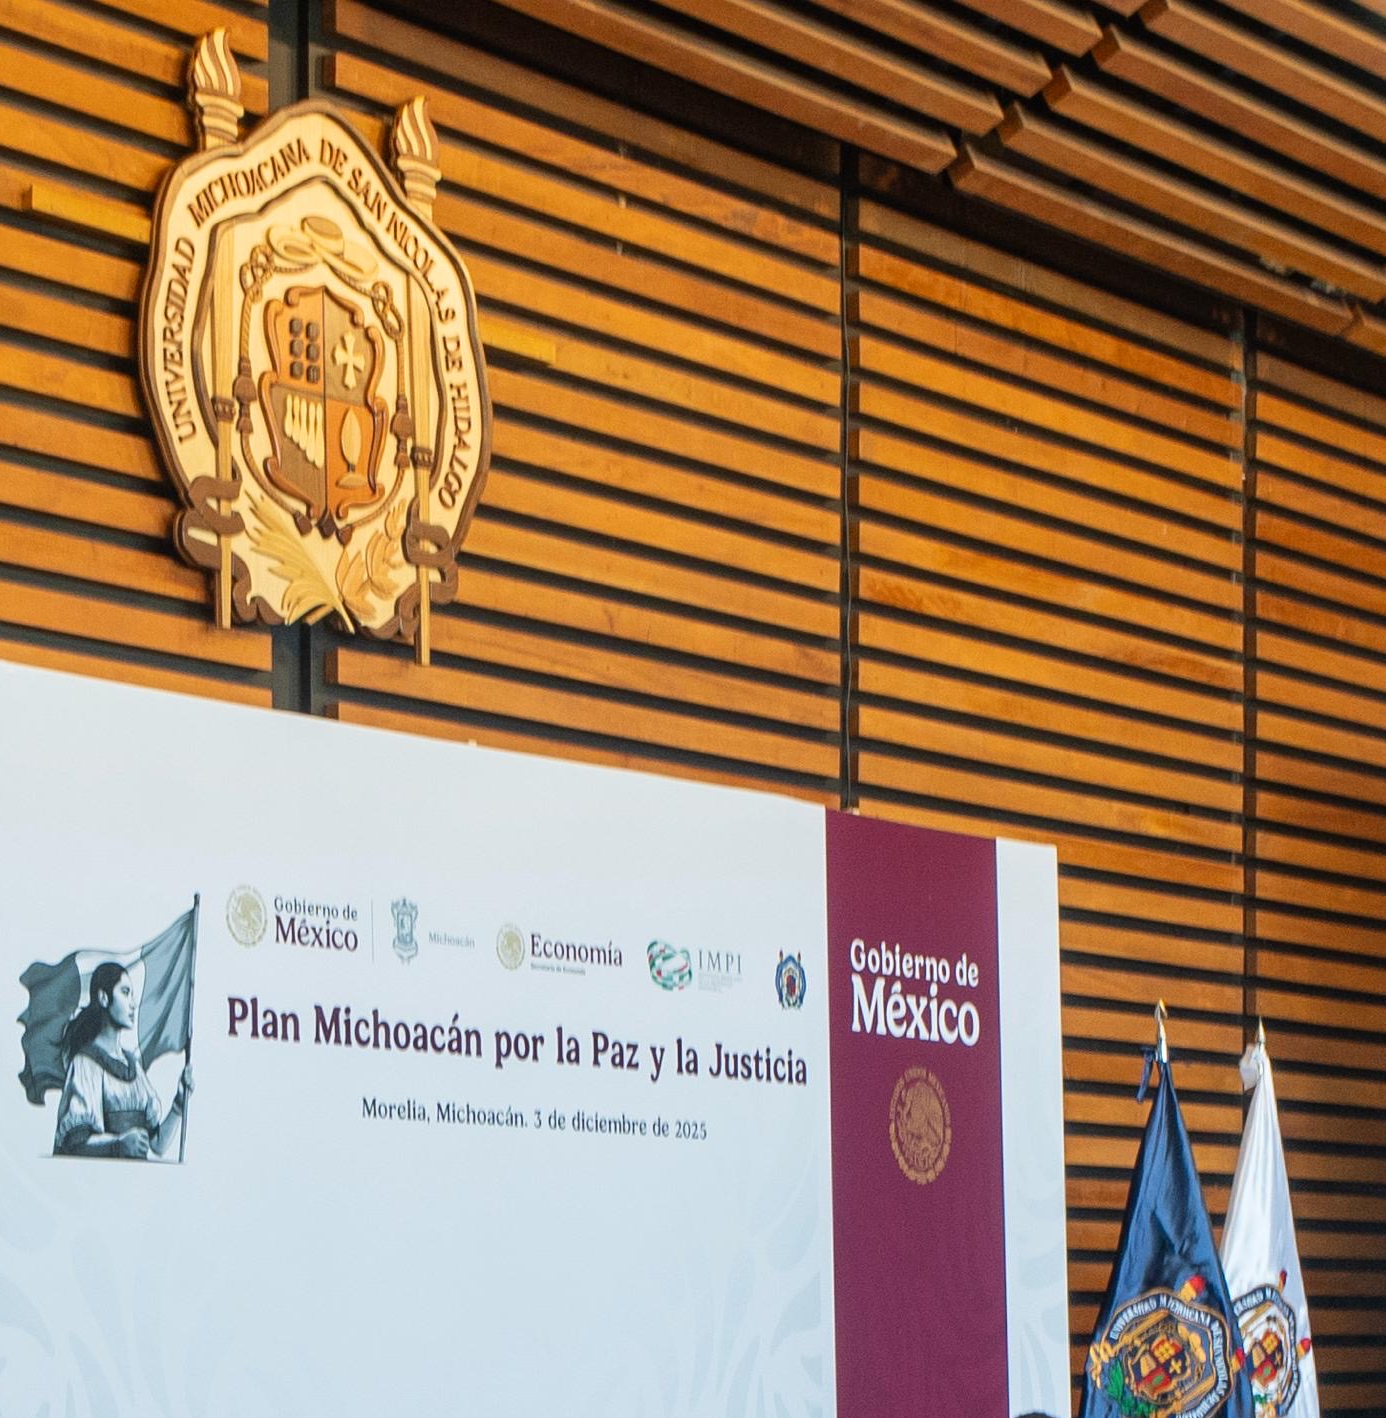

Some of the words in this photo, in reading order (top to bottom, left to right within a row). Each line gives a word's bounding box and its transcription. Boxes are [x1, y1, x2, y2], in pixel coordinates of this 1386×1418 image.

[319, 138, 346, 176] DE
[187, 138, 310, 229] MICHOACANA
[348, 168, 387, 221] SAN
[387, 218, 456, 325] NICOLAS
[163, 237, 196, 443] UNIVERSIDAD
[442, 335, 462, 373] DE
[437, 379, 472, 509] HIDALGO
[274, 896, 338, 920] Gobierno
[343, 905, 358, 922] de
[275, 915, 358, 952] México
[530, 934, 623, 967] Economía
[698, 950, 742, 974] IMPI
[850, 938, 950, 984] Gobierno
[955, 953, 980, 988] de
[851, 972, 981, 1047] México
[228, 996, 301, 1042] Plan
[314, 1005, 483, 1057] Michoacán
[494, 1029, 545, 1069] por
[556, 1025, 581, 1065] la
[592, 1031, 639, 1071] Paz
[650, 1043, 665, 1082] y
[676, 1037, 699, 1076] la
[708, 1043, 808, 1086] Justicia
[362, 1097, 430, 1124] Morelia,
[436, 1101, 528, 1128] Michoacán.
[533, 1109, 542, 1129] 3
[548, 1109, 566, 1130] de
[572, 1110, 647, 1136] diciembre
[652, 1117, 669, 1138] de
[675, 1120, 707, 1140] 2025
